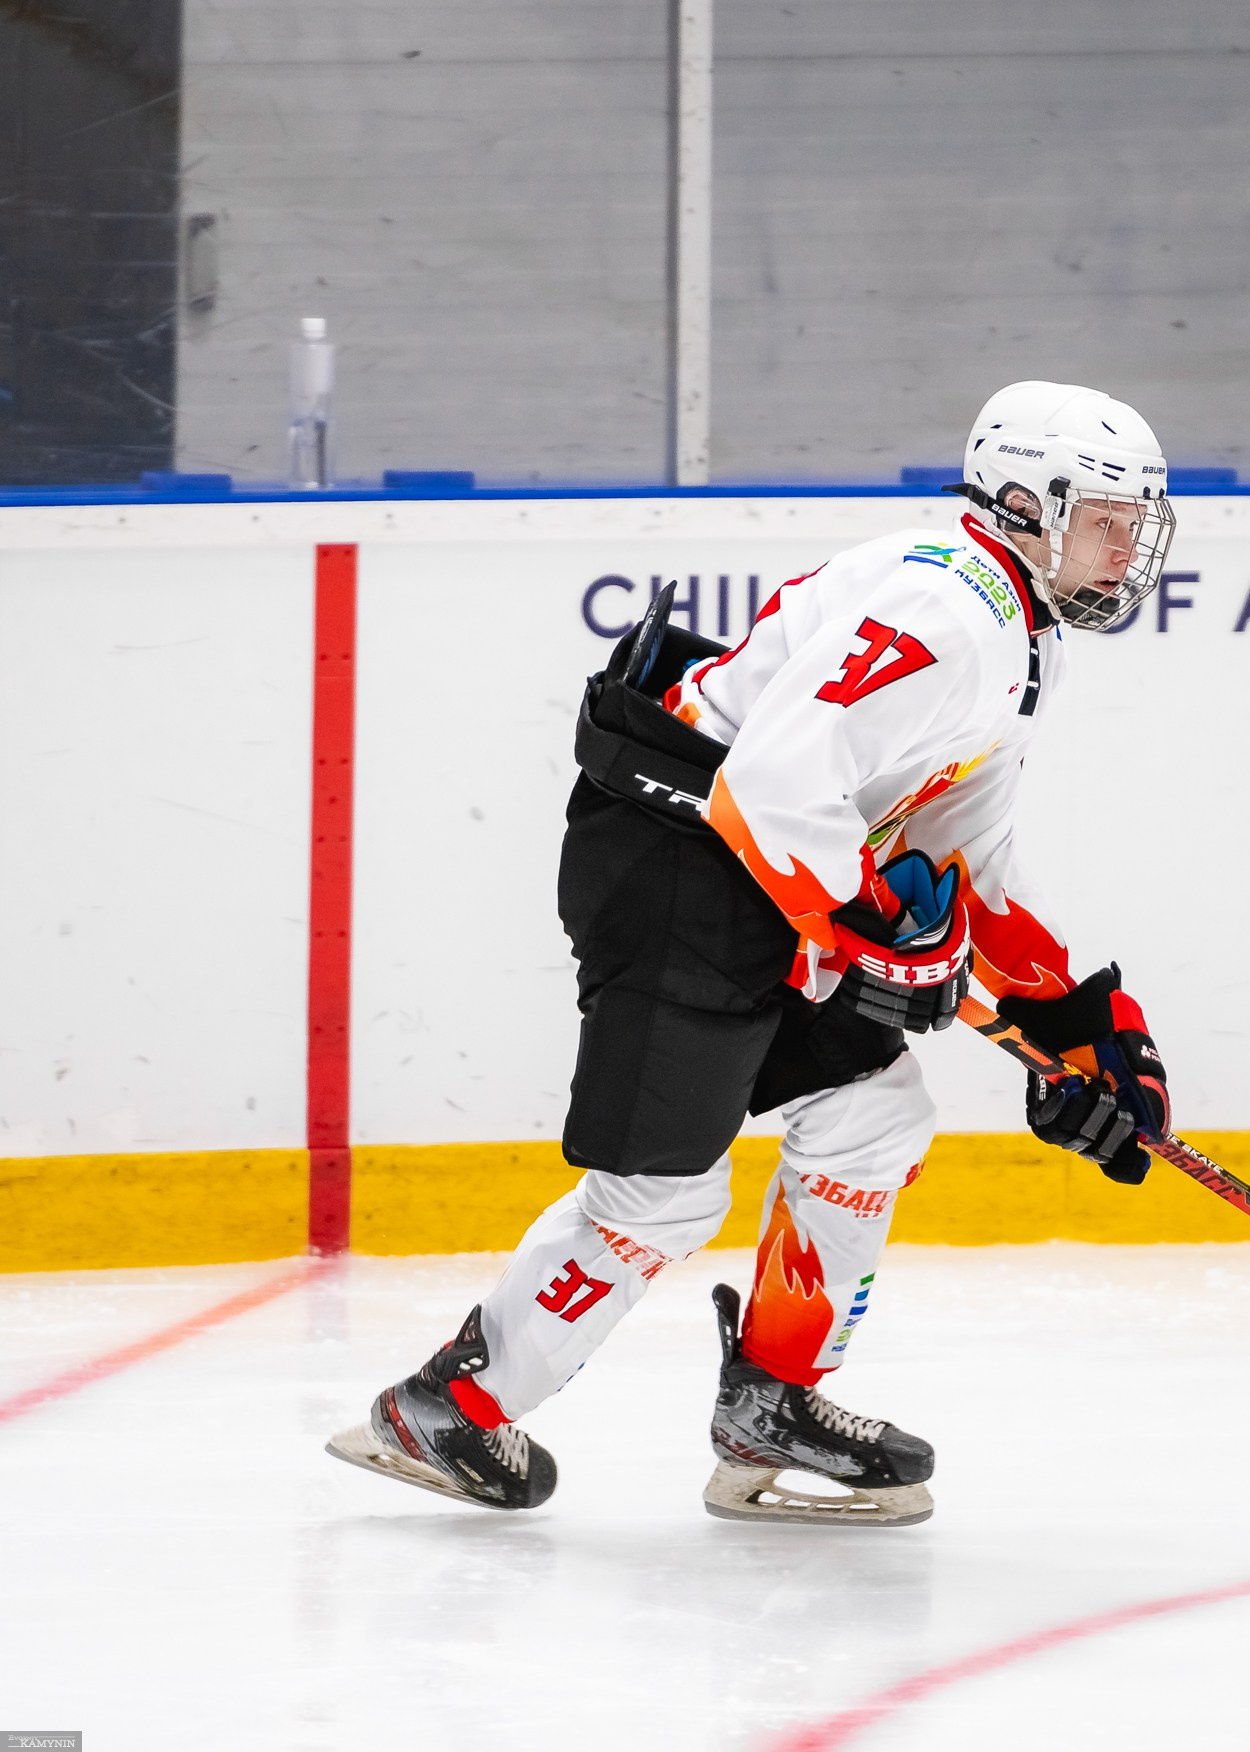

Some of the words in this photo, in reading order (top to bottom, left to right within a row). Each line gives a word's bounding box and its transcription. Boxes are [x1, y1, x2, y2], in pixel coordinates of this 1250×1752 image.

[997, 444, 1045, 459] BAUER
[1141, 465, 1166, 475] BAUER
[991, 503, 1028, 527] BAUER
[961, 560, 1017, 621] 2023
[814, 616, 939, 709] 37
[1181, 1143, 1224, 1175] SKATE
[535, 1258, 616, 1323] 37
